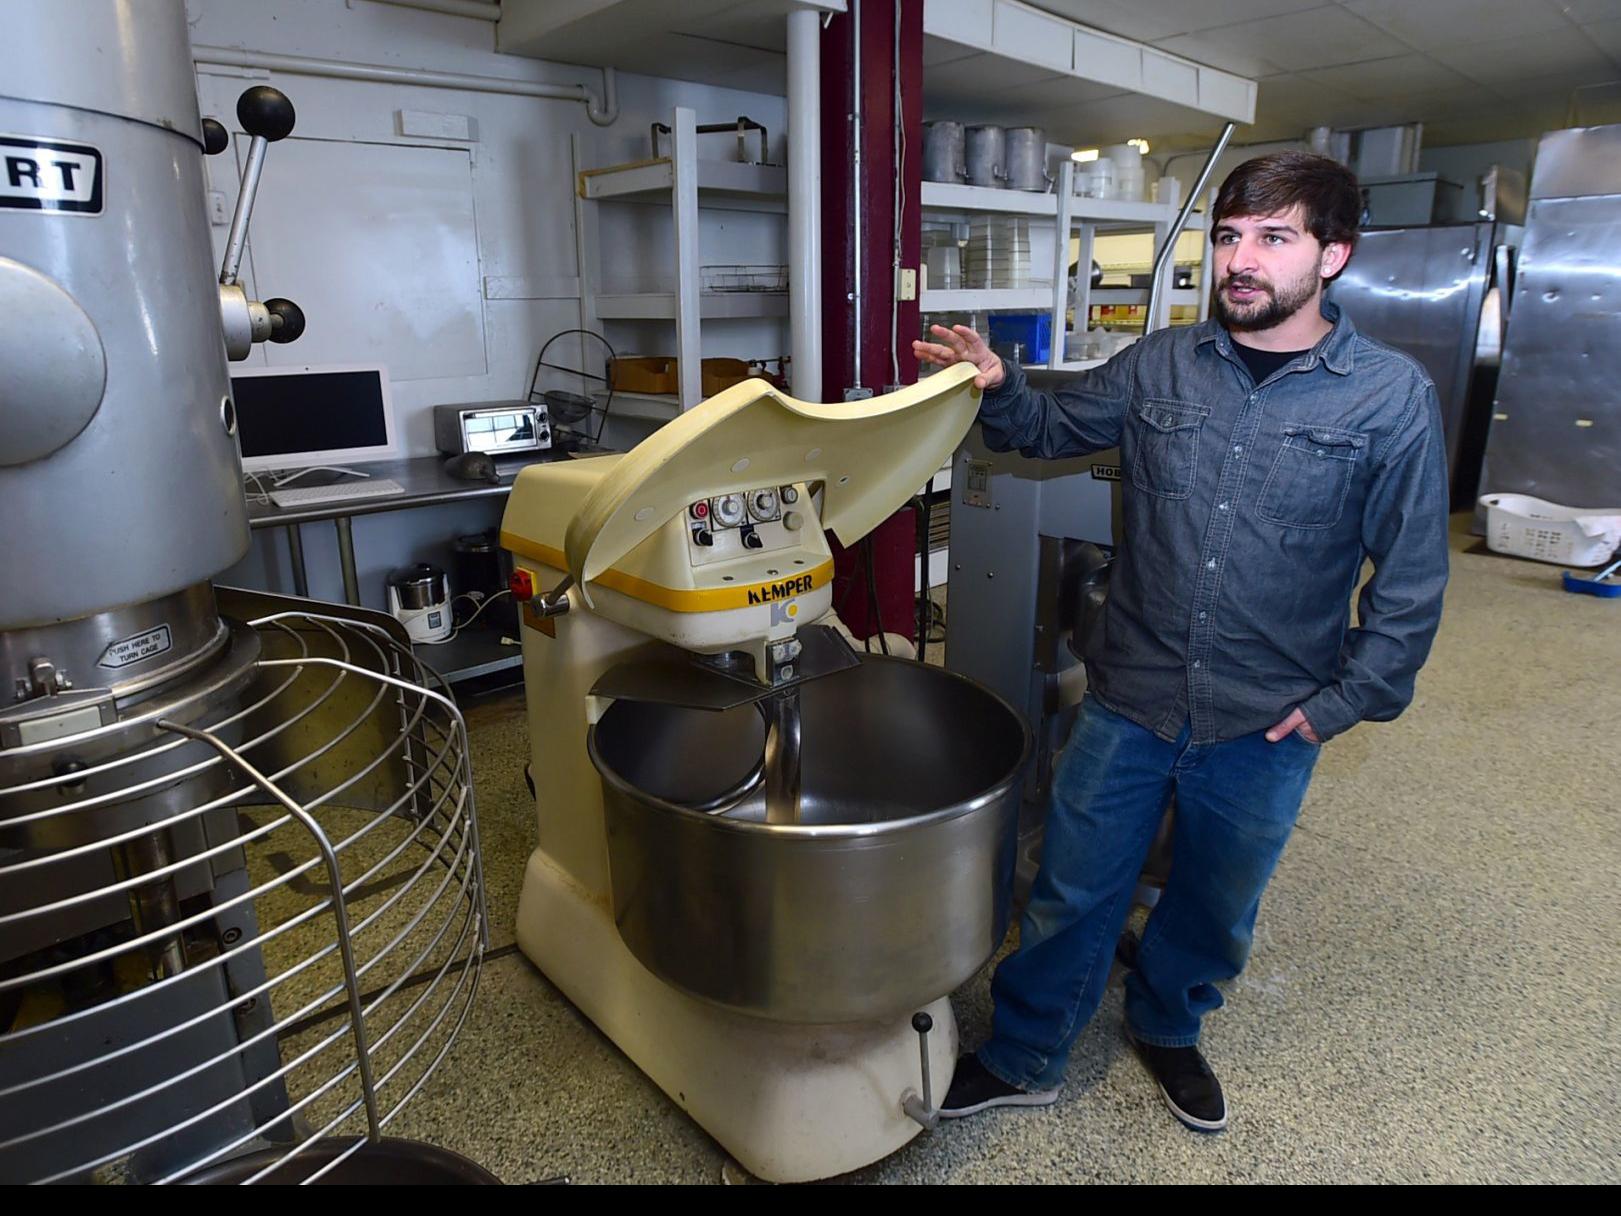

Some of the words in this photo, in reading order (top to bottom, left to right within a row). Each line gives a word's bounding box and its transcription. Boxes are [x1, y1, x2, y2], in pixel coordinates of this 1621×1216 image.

[748, 574, 813, 604] KEMPER
[109, 645, 129, 657] PUSH
[132, 637, 150, 649] HERE
[152, 633, 161, 641] TO
[120, 651, 138, 662] TURN
[141, 643, 159, 655] CAGE
